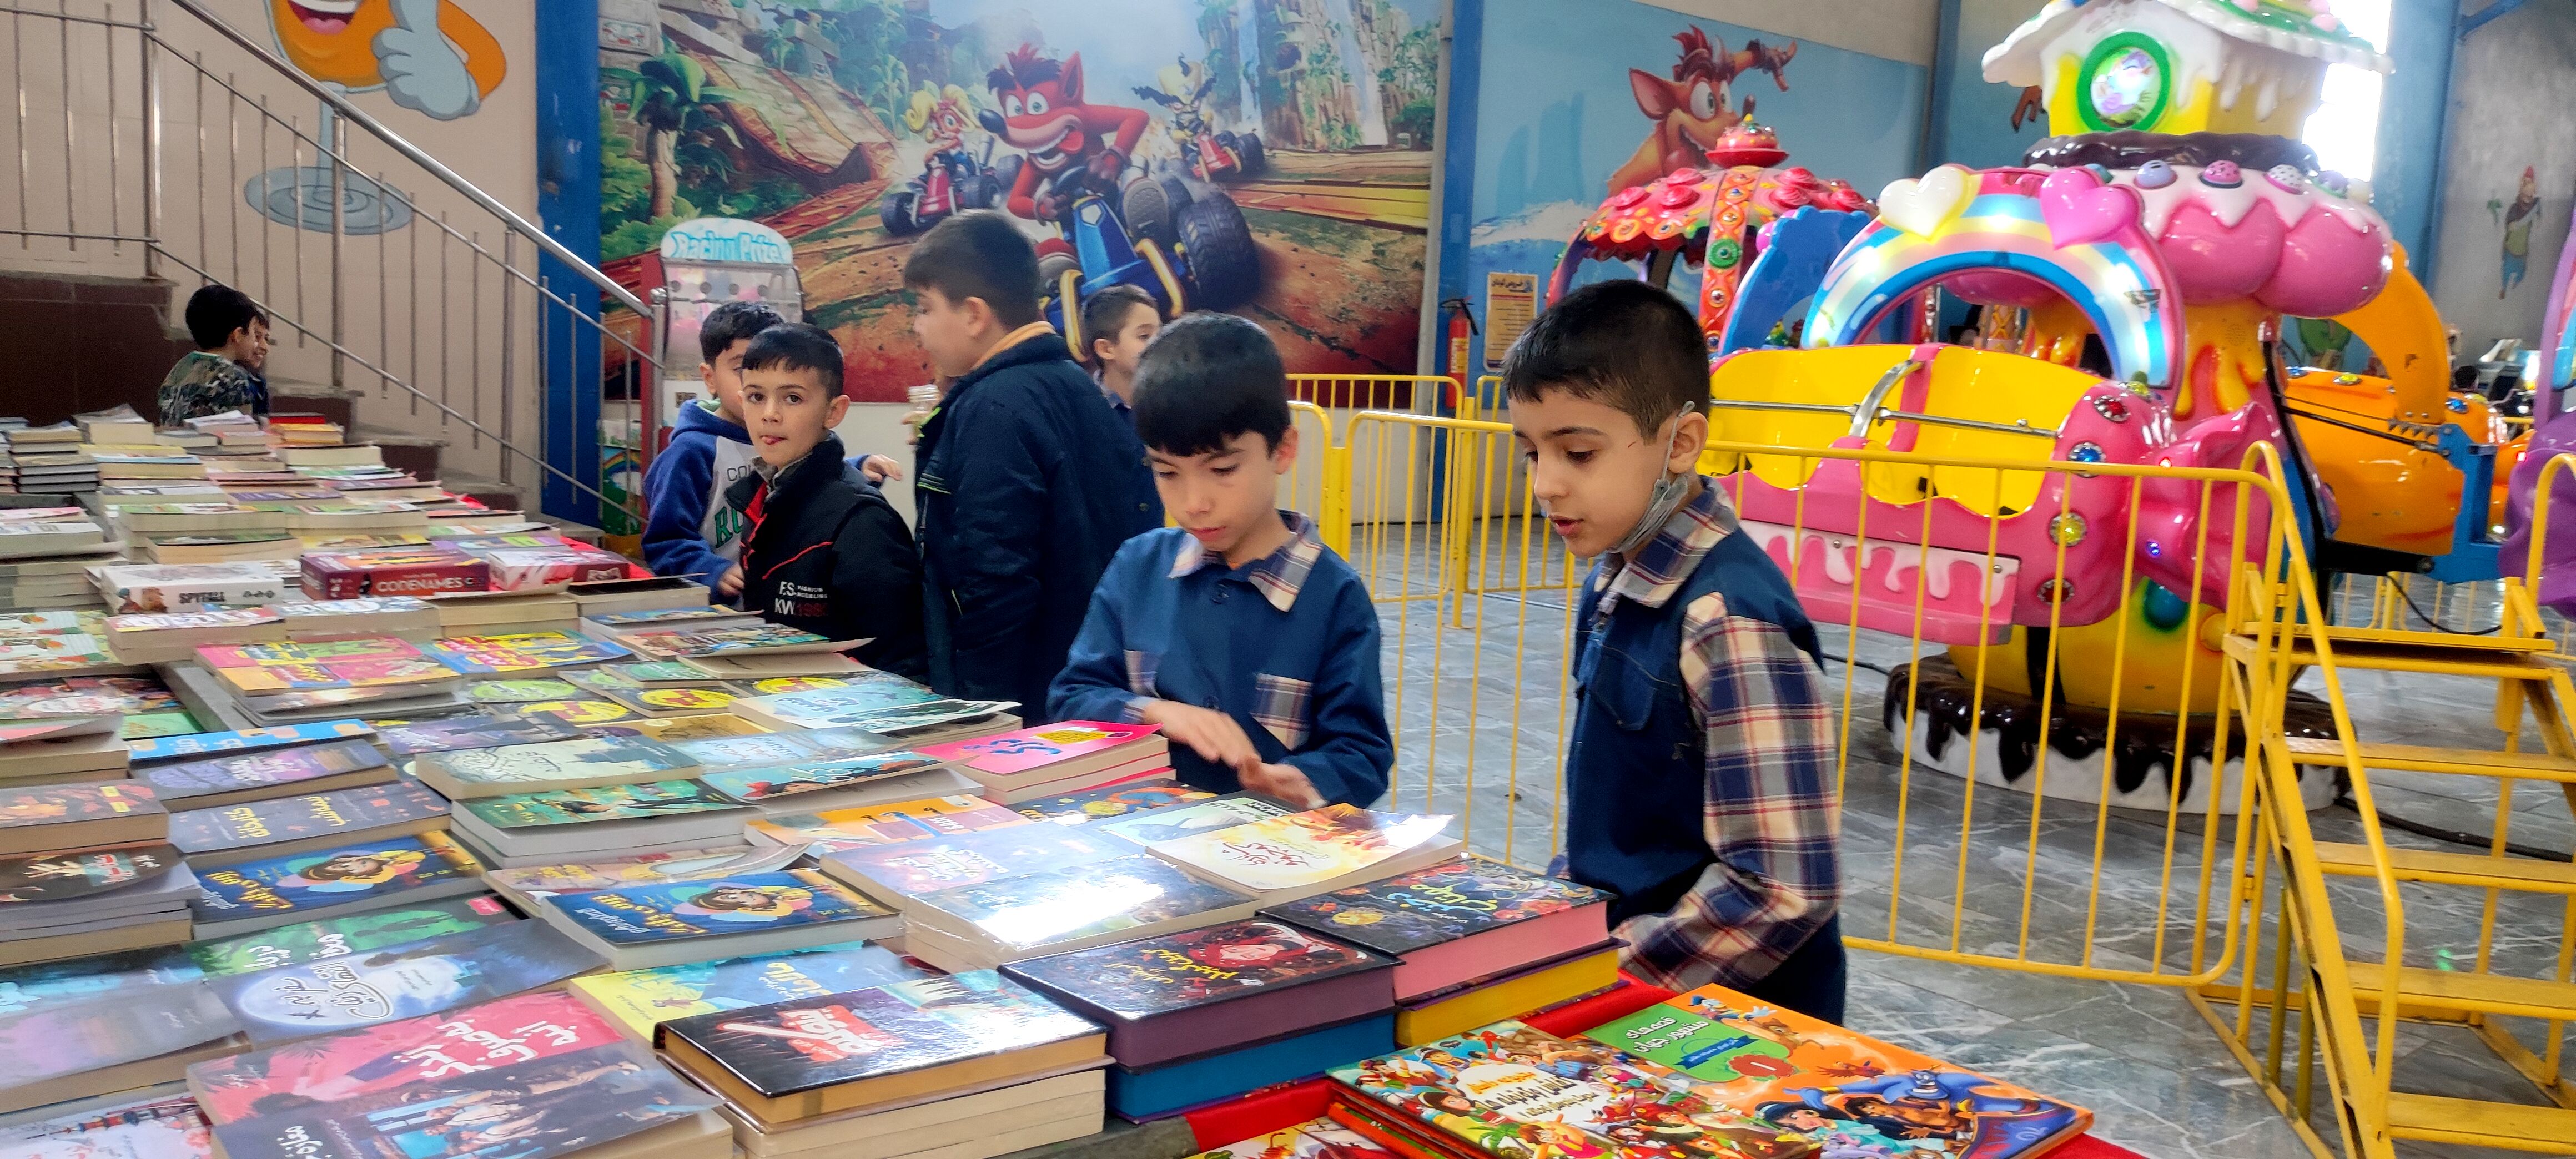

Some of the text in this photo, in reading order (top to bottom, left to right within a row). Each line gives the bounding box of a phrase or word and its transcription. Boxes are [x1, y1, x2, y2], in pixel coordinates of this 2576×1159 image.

[375, 576, 464, 592] CODENAMES
[928, 817, 965, 830] SAM
[1386, 891, 1495, 917] دختر
[1408, 880, 1498, 911] مهتاب
[511, 1020, 581, 1047] انبه
[1665, 1020, 1711, 1041] مشهور
[1633, 1036, 1670, 1054] جهان
